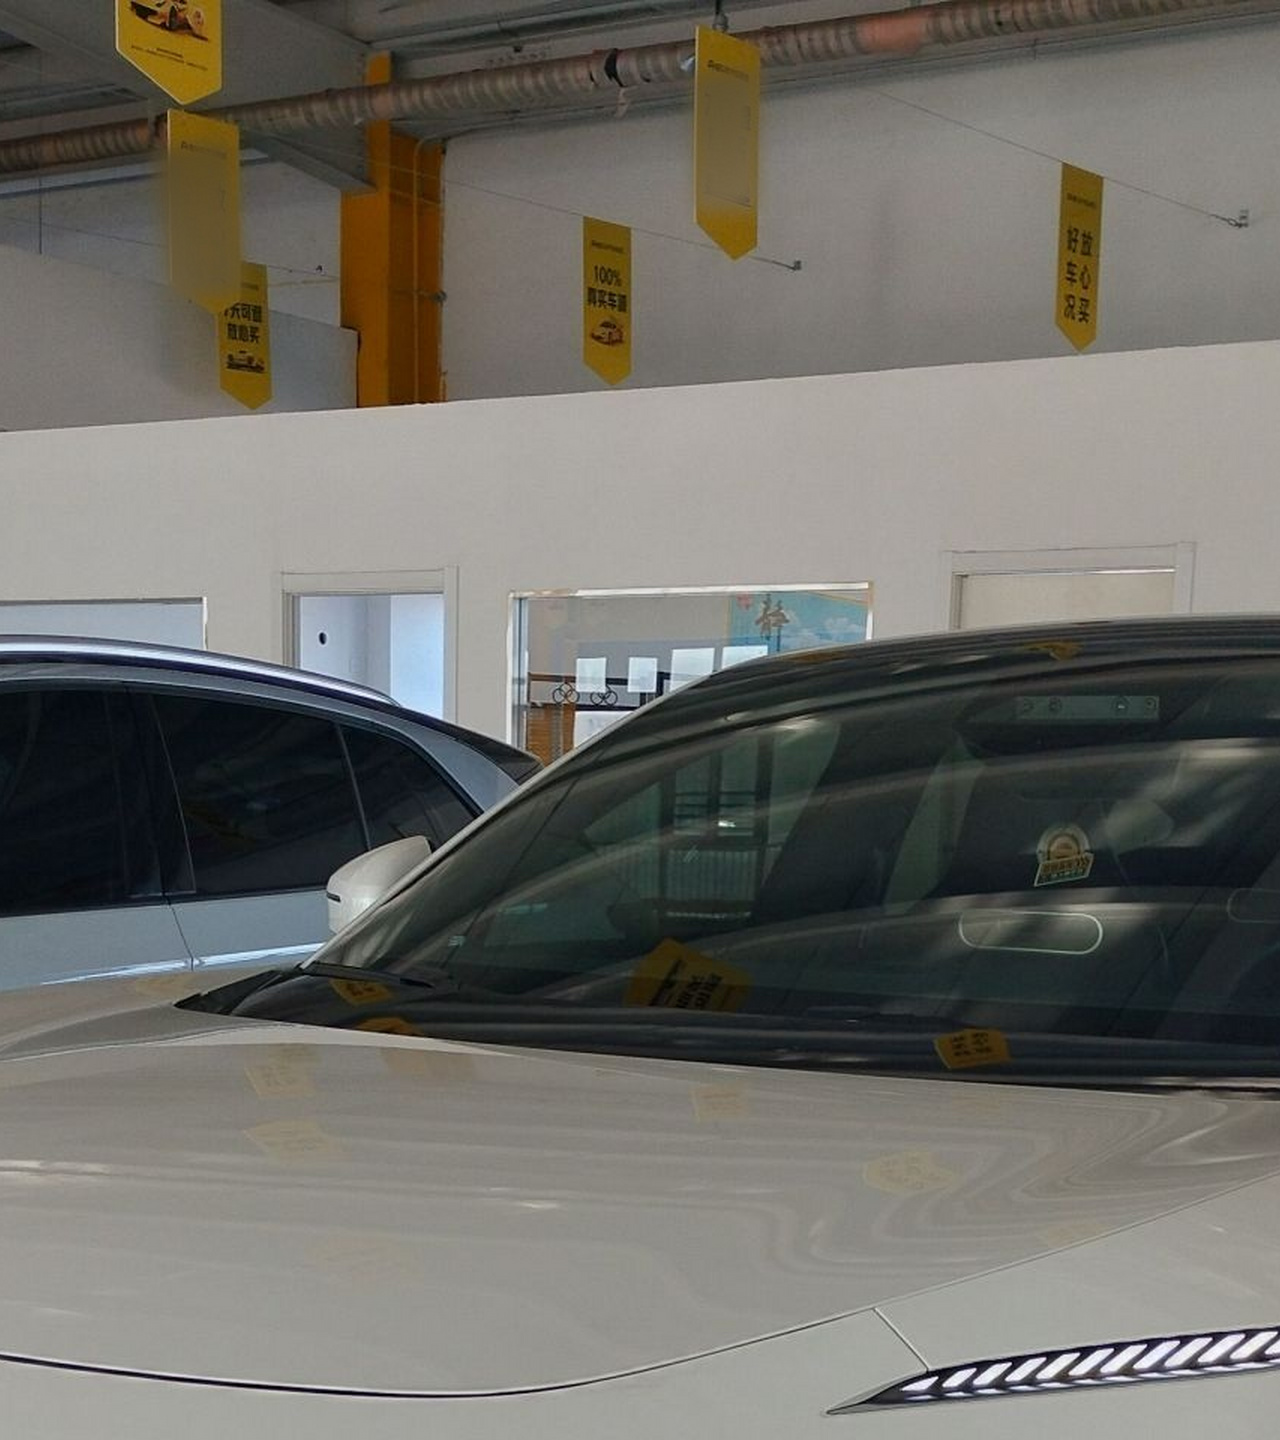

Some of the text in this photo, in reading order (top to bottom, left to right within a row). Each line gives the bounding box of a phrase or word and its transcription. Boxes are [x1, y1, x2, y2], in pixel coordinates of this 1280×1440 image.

[593, 265, 623, 287] 100%
[1064, 227, 1080, 322] 好车况
[1077, 229, 1094, 324] 放心买
